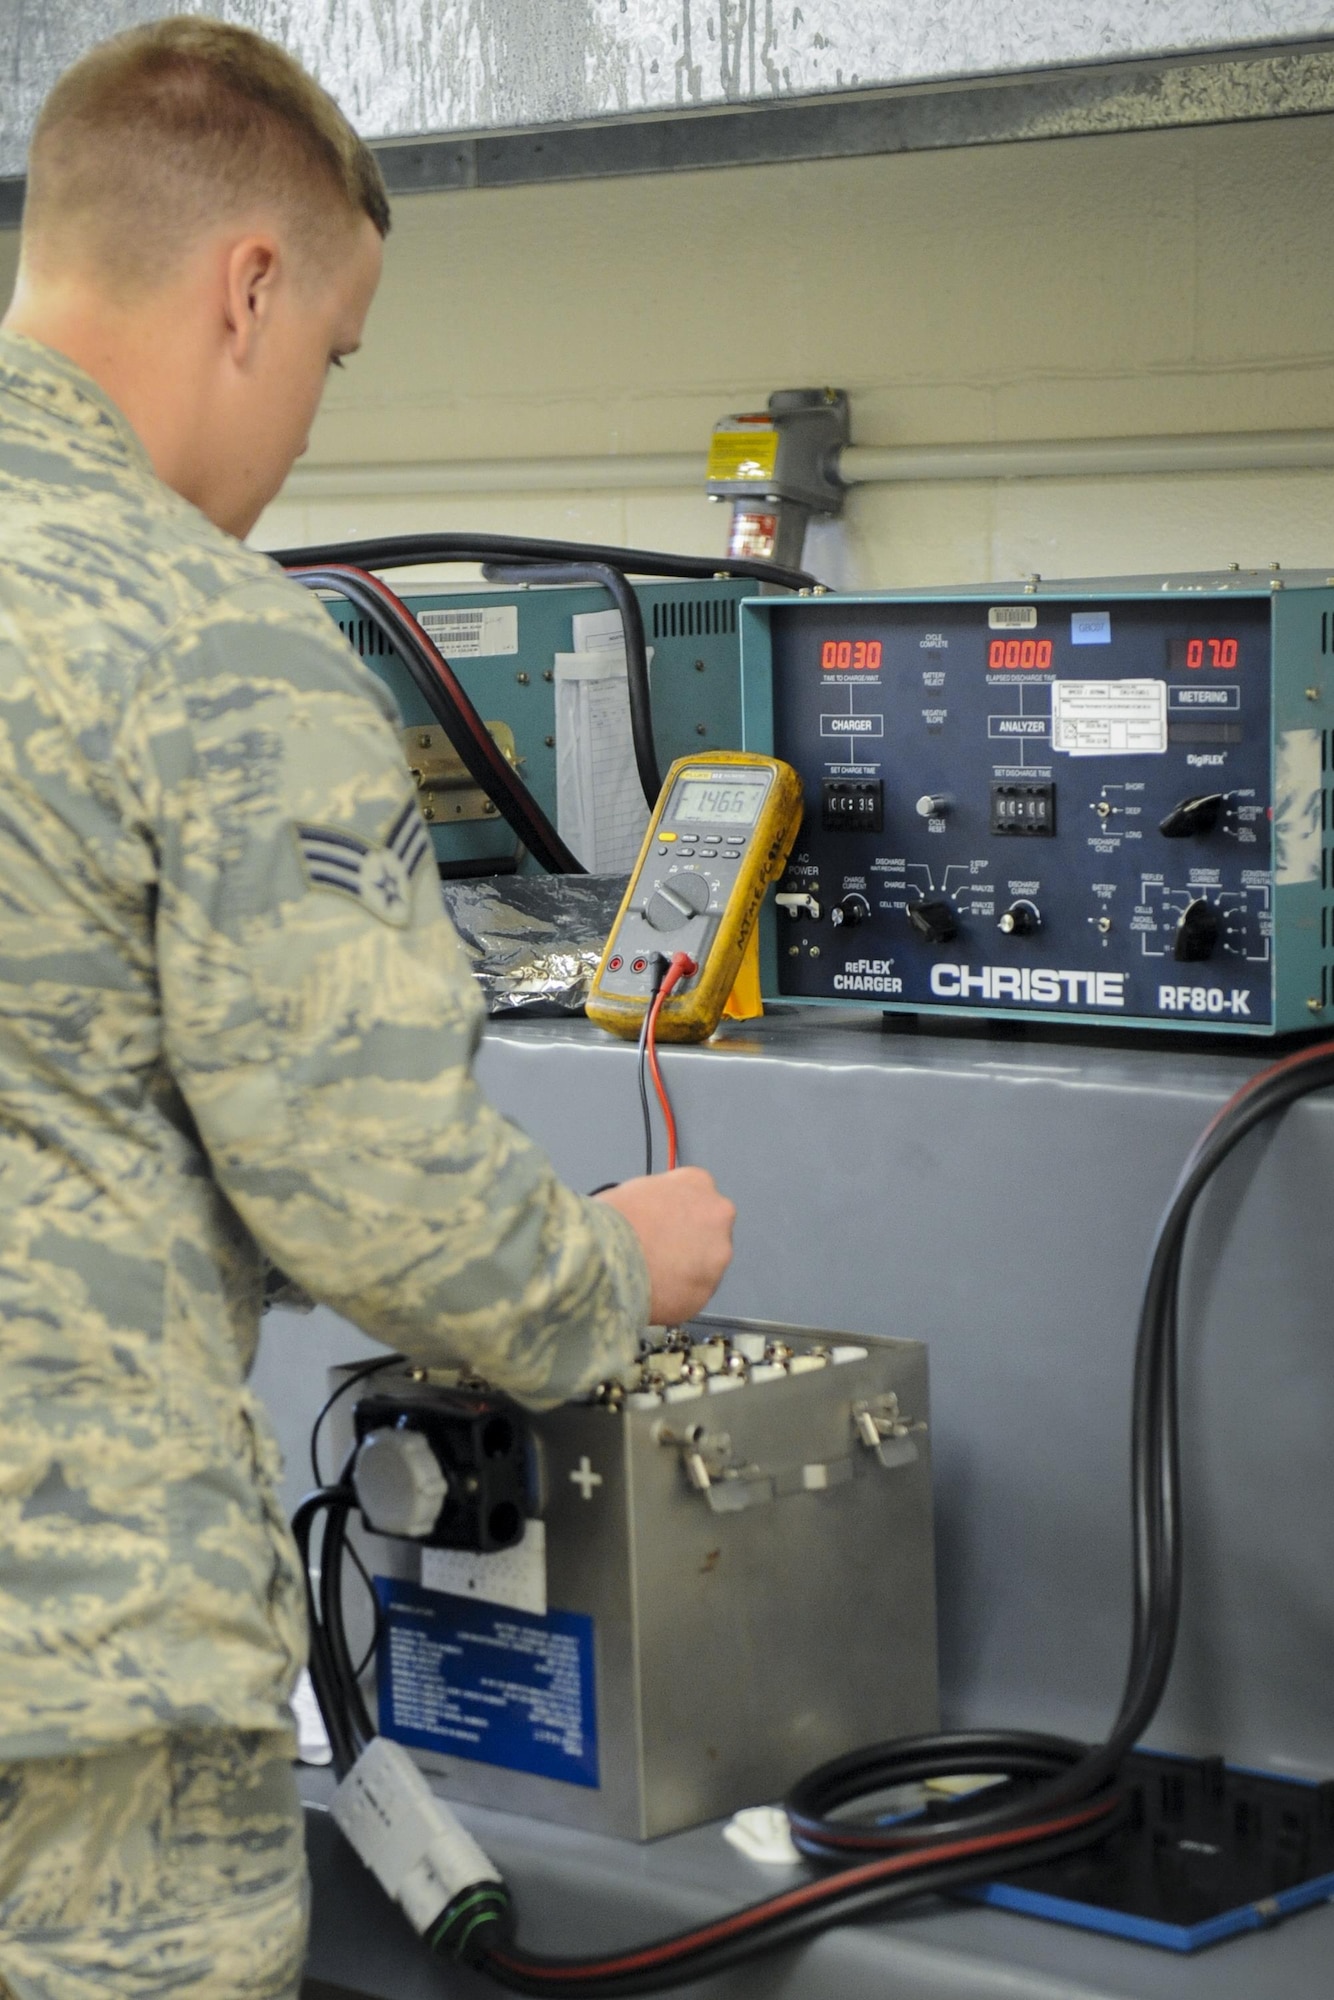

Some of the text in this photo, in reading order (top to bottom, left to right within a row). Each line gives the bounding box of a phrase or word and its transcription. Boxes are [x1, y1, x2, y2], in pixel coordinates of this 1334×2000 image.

[822, 641, 882, 669] 0030
[989, 640, 1052, 669] 0000
[1187, 640, 1238, 668] 070
[1179, 691, 1228, 702] METERING
[832, 719, 872, 731] CHARGER
[999, 720, 1045, 732] ANALYZER
[842, 766, 862, 774] CHARGE
[1006, 769, 1037, 777] DISCHARGE
[798, 853, 809, 862] AC
[876, 858, 905, 866] DISCHARGE
[788, 866, 819, 875] POWER
[842, 882, 866, 890] CURRENT
[1008, 880, 1040, 888] DISCHARGE
[833, 974, 902, 993] CHARGER
[930, 963, 1125, 1006] CHRISTIE
[1159, 985, 1250, 1015] RF80-K
